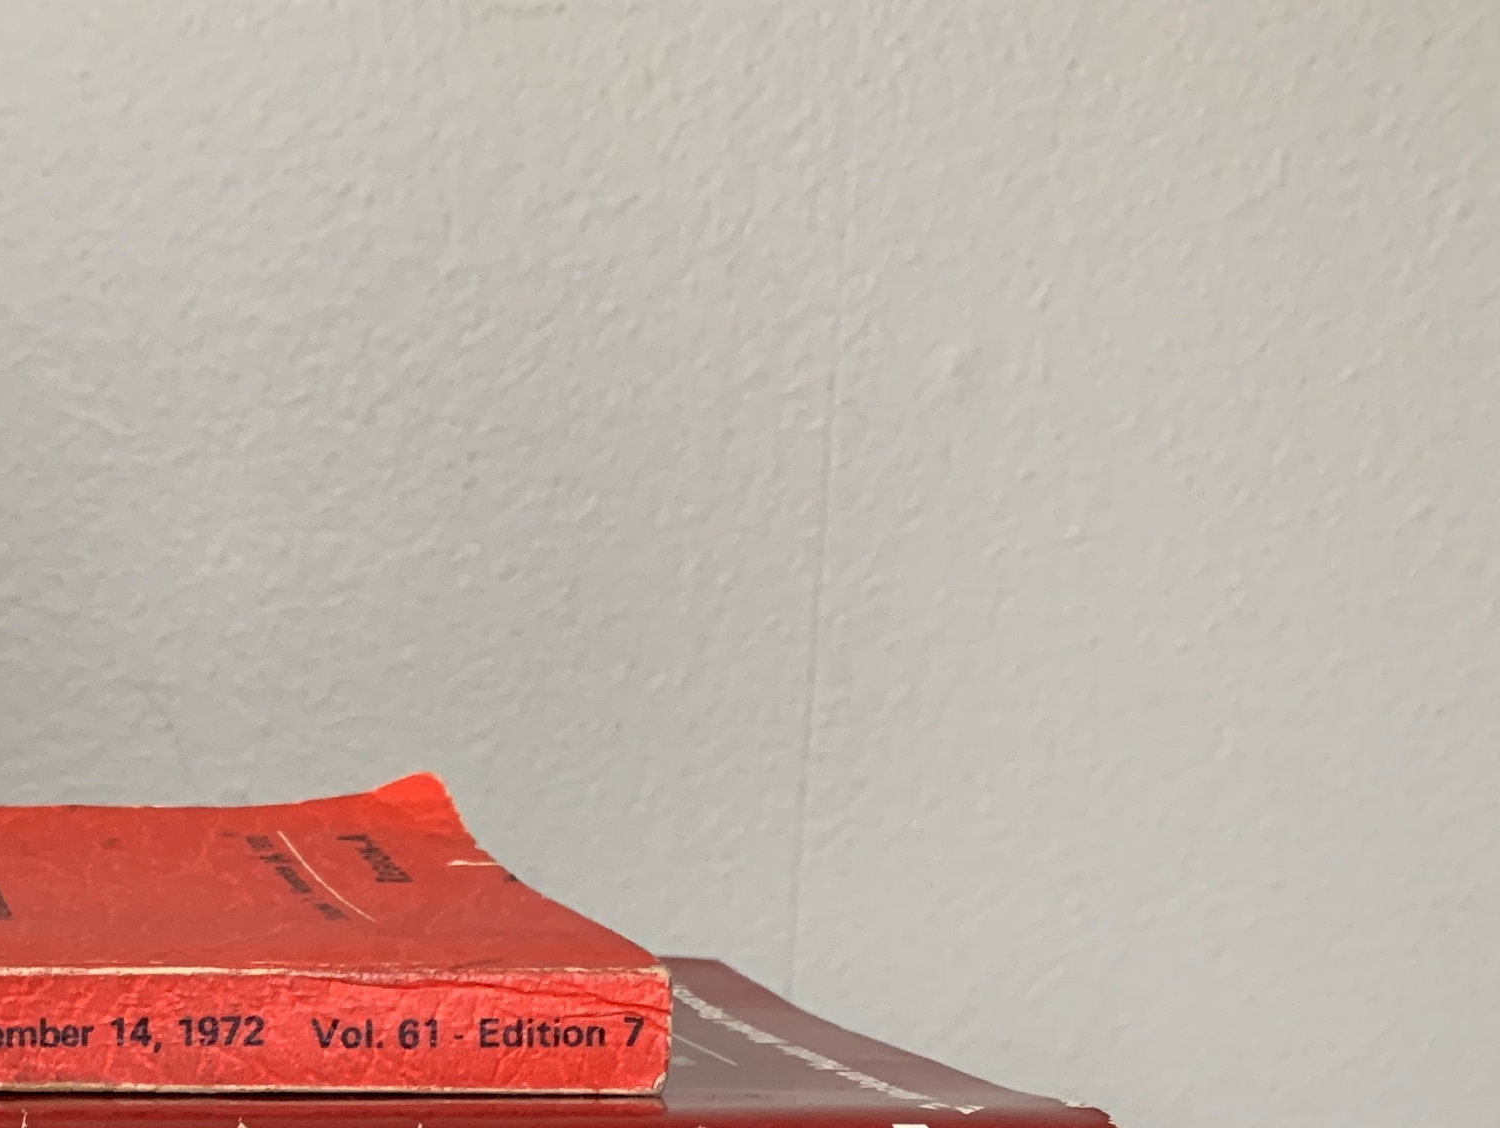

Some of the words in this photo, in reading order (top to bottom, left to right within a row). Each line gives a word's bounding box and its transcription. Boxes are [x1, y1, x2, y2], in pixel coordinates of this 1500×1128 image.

[110, 1016, 162, 1055] 14,
[177, 1015, 265, 1047] 1972
[311, 1017, 384, 1050] Vol.
[397, 1018, 438, 1050] 61
[478, 1016, 607, 1049] Edition
[623, 1016, 645, 1048] 7
